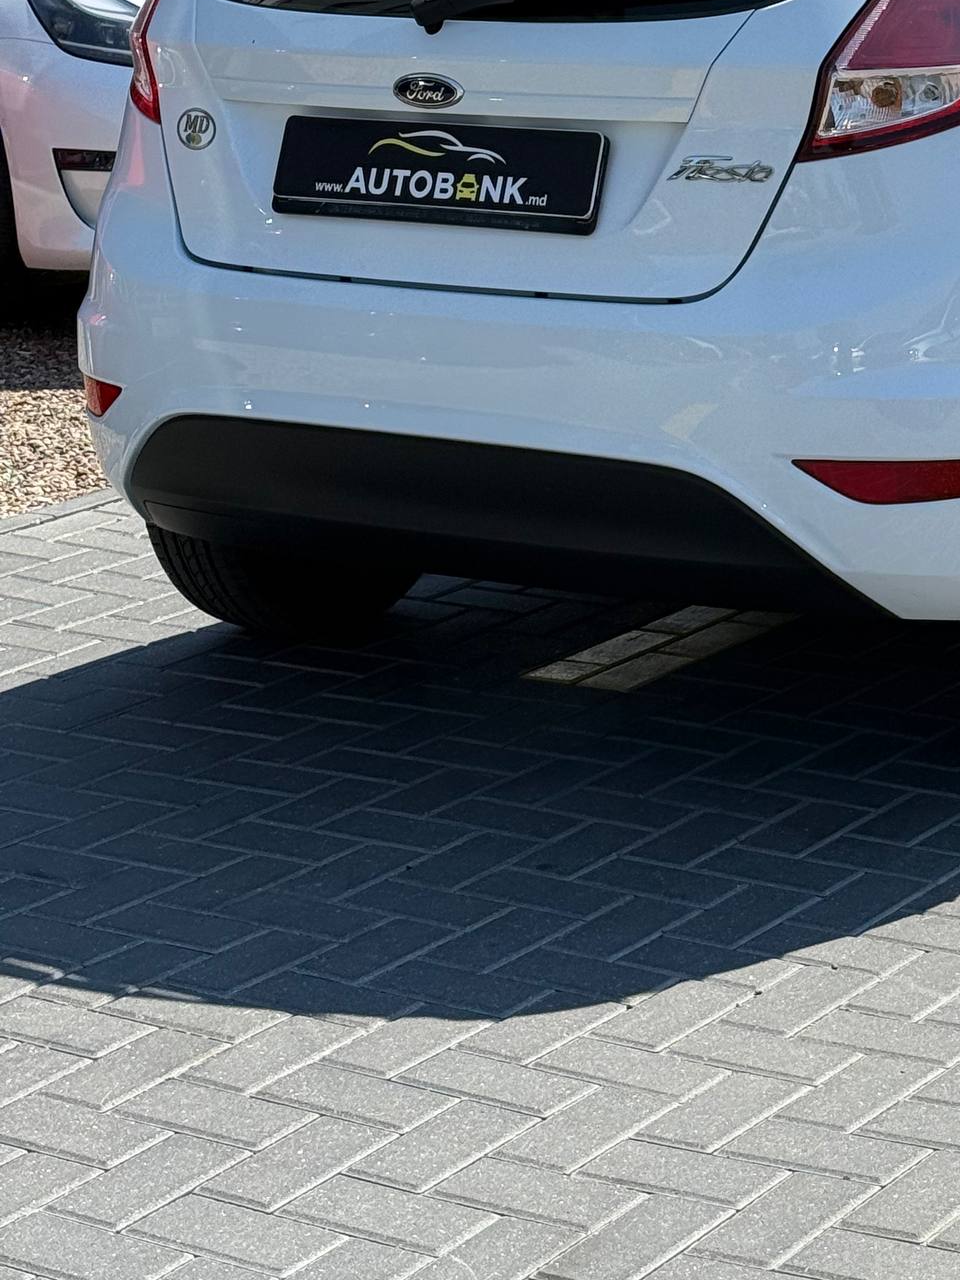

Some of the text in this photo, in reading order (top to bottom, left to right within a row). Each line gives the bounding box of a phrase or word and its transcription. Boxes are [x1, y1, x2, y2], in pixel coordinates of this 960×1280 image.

[406, 79, 445, 101] Ford
[183, 113, 210, 135] MD
[666, 155, 775, 183] Fiesta
